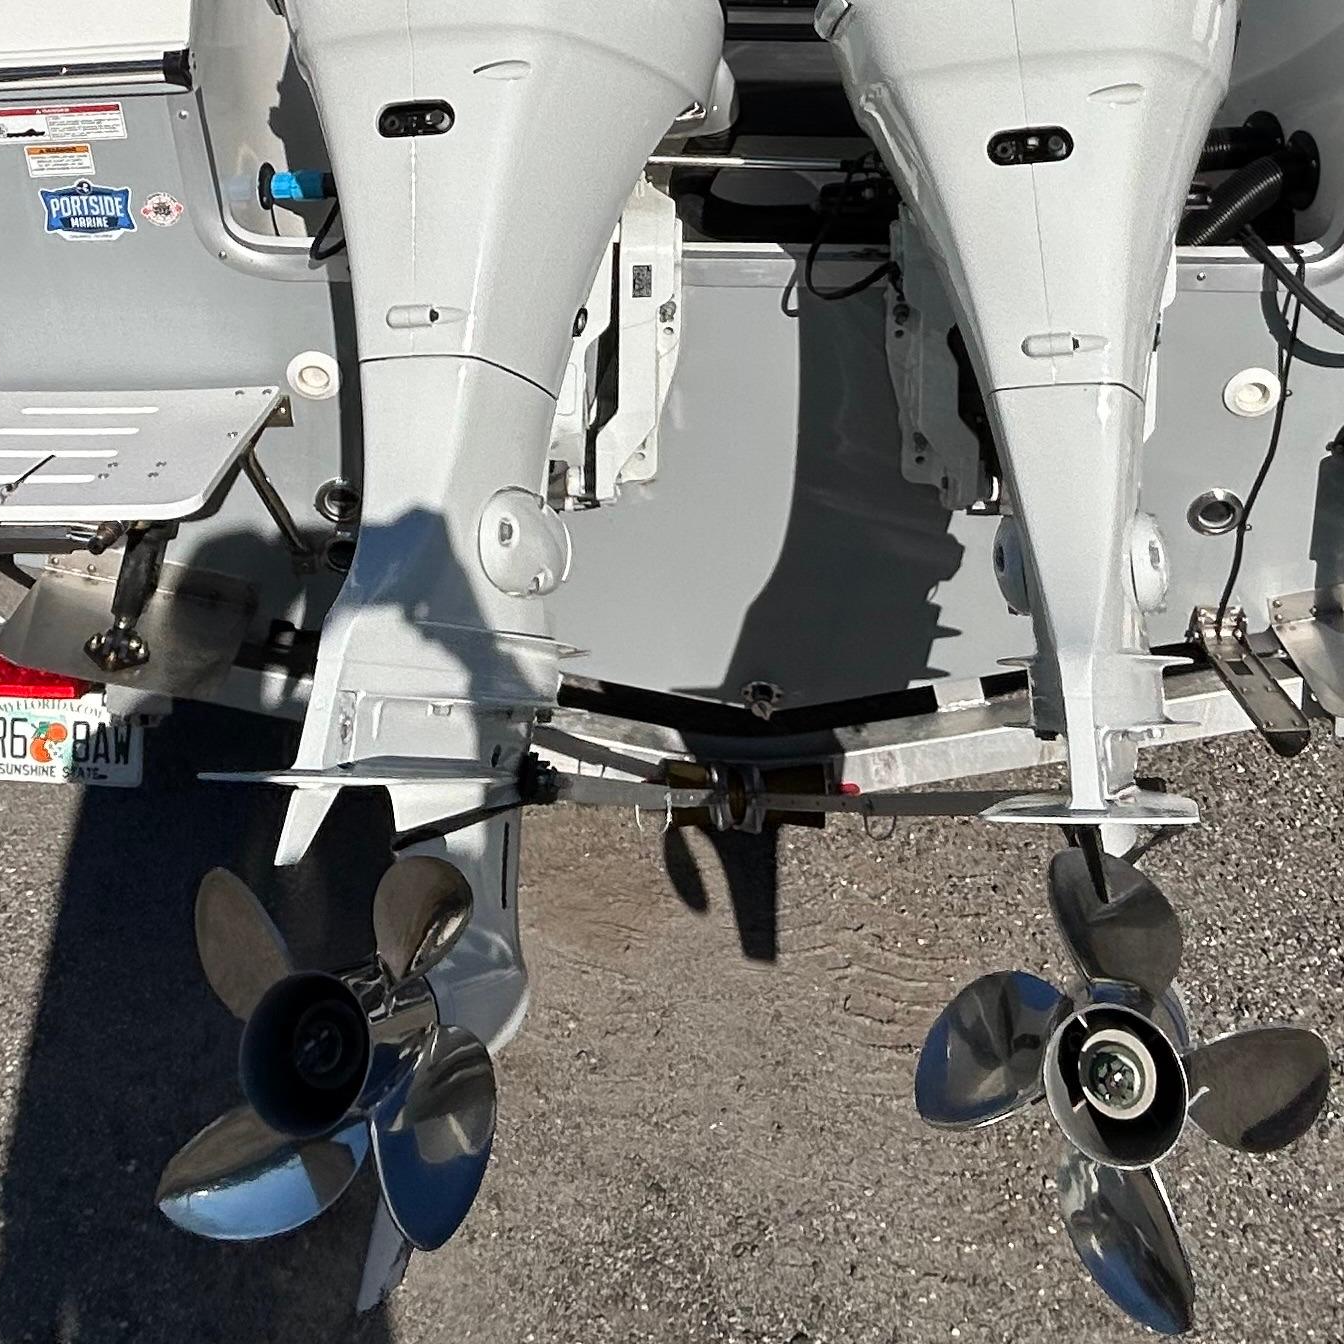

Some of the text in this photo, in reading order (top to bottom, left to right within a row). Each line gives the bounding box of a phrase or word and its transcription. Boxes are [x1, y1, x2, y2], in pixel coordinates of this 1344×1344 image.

[49, 194, 124, 219] PORTSIDE
[70, 216, 109, 229] MARINE
[62, 766, 100, 780] STATE
